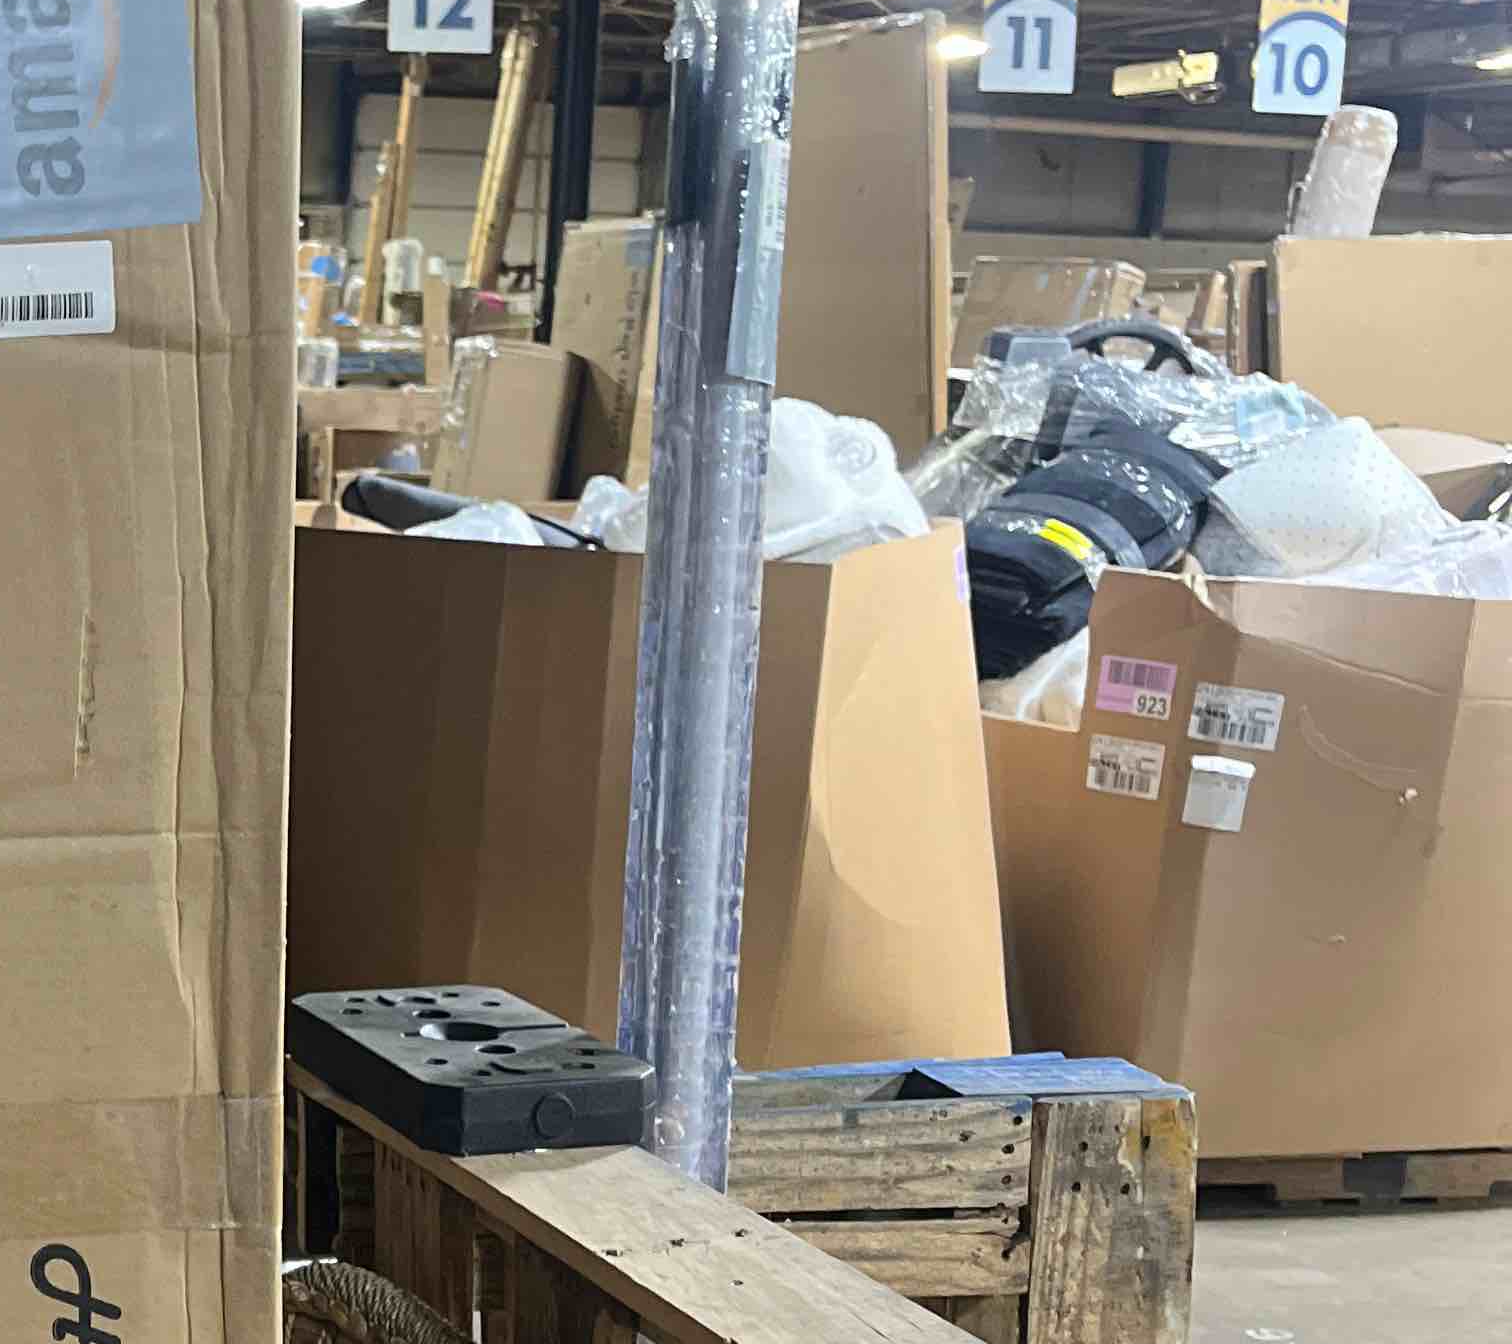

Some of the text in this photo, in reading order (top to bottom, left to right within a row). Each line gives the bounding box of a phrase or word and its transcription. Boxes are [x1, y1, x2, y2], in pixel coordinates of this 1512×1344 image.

[1007, 16, 1052, 70] 11
[1270, 43, 1330, 96] 10
[1136, 694, 1168, 717] 923
